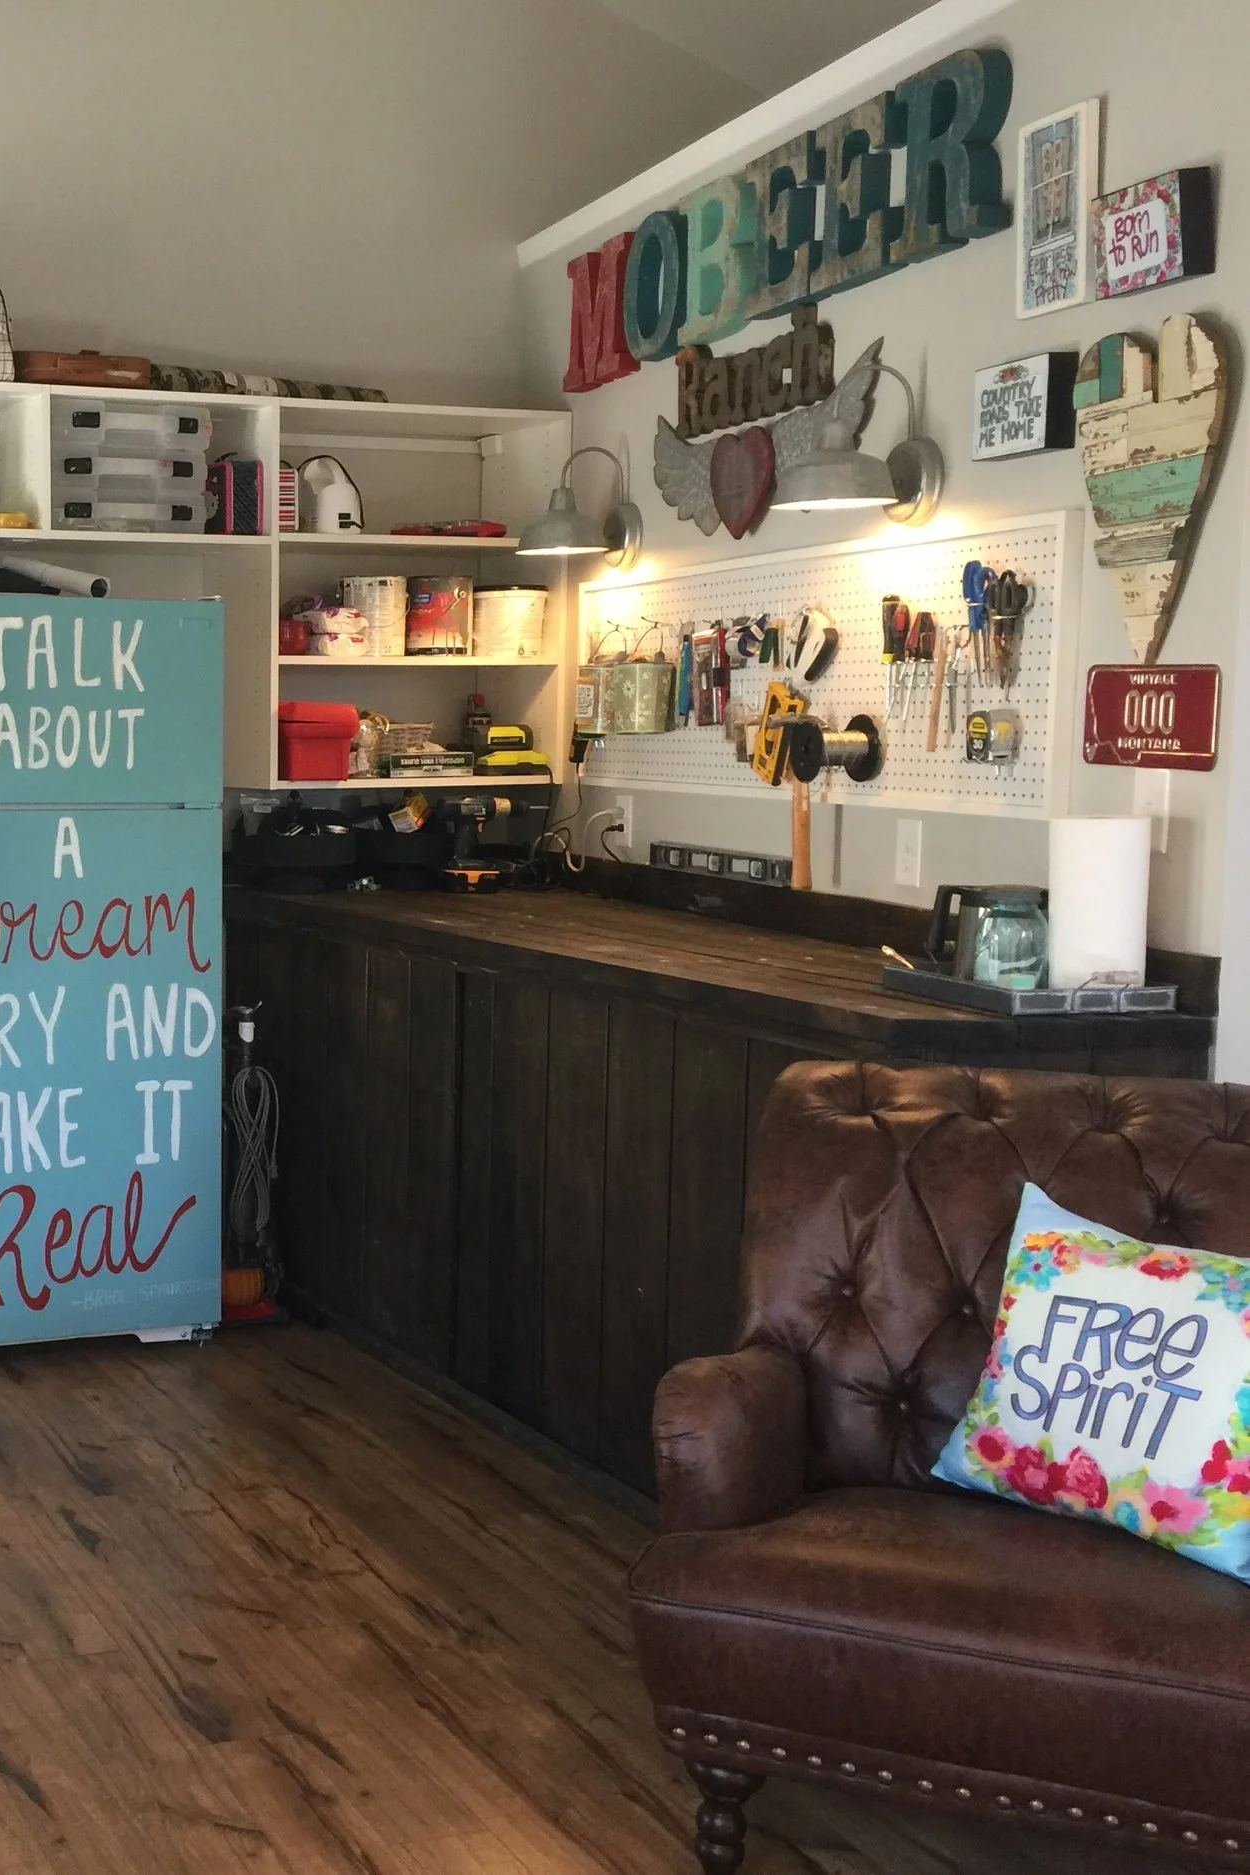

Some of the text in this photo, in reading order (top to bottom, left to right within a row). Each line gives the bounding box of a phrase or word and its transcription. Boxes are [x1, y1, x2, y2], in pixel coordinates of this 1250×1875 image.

[563, 48, 1014, 393] MOBEER
[981, 376, 1036, 409] COUNTRY
[979, 418, 1034, 448] ME HOME
[1130, 674, 1178, 685] VINTAGE
[1118, 737, 1181, 750] MONTANA
[54, 816, 83, 878] A
[106, 983, 216, 1061] AND
[135, 1080, 193, 1165] IT
